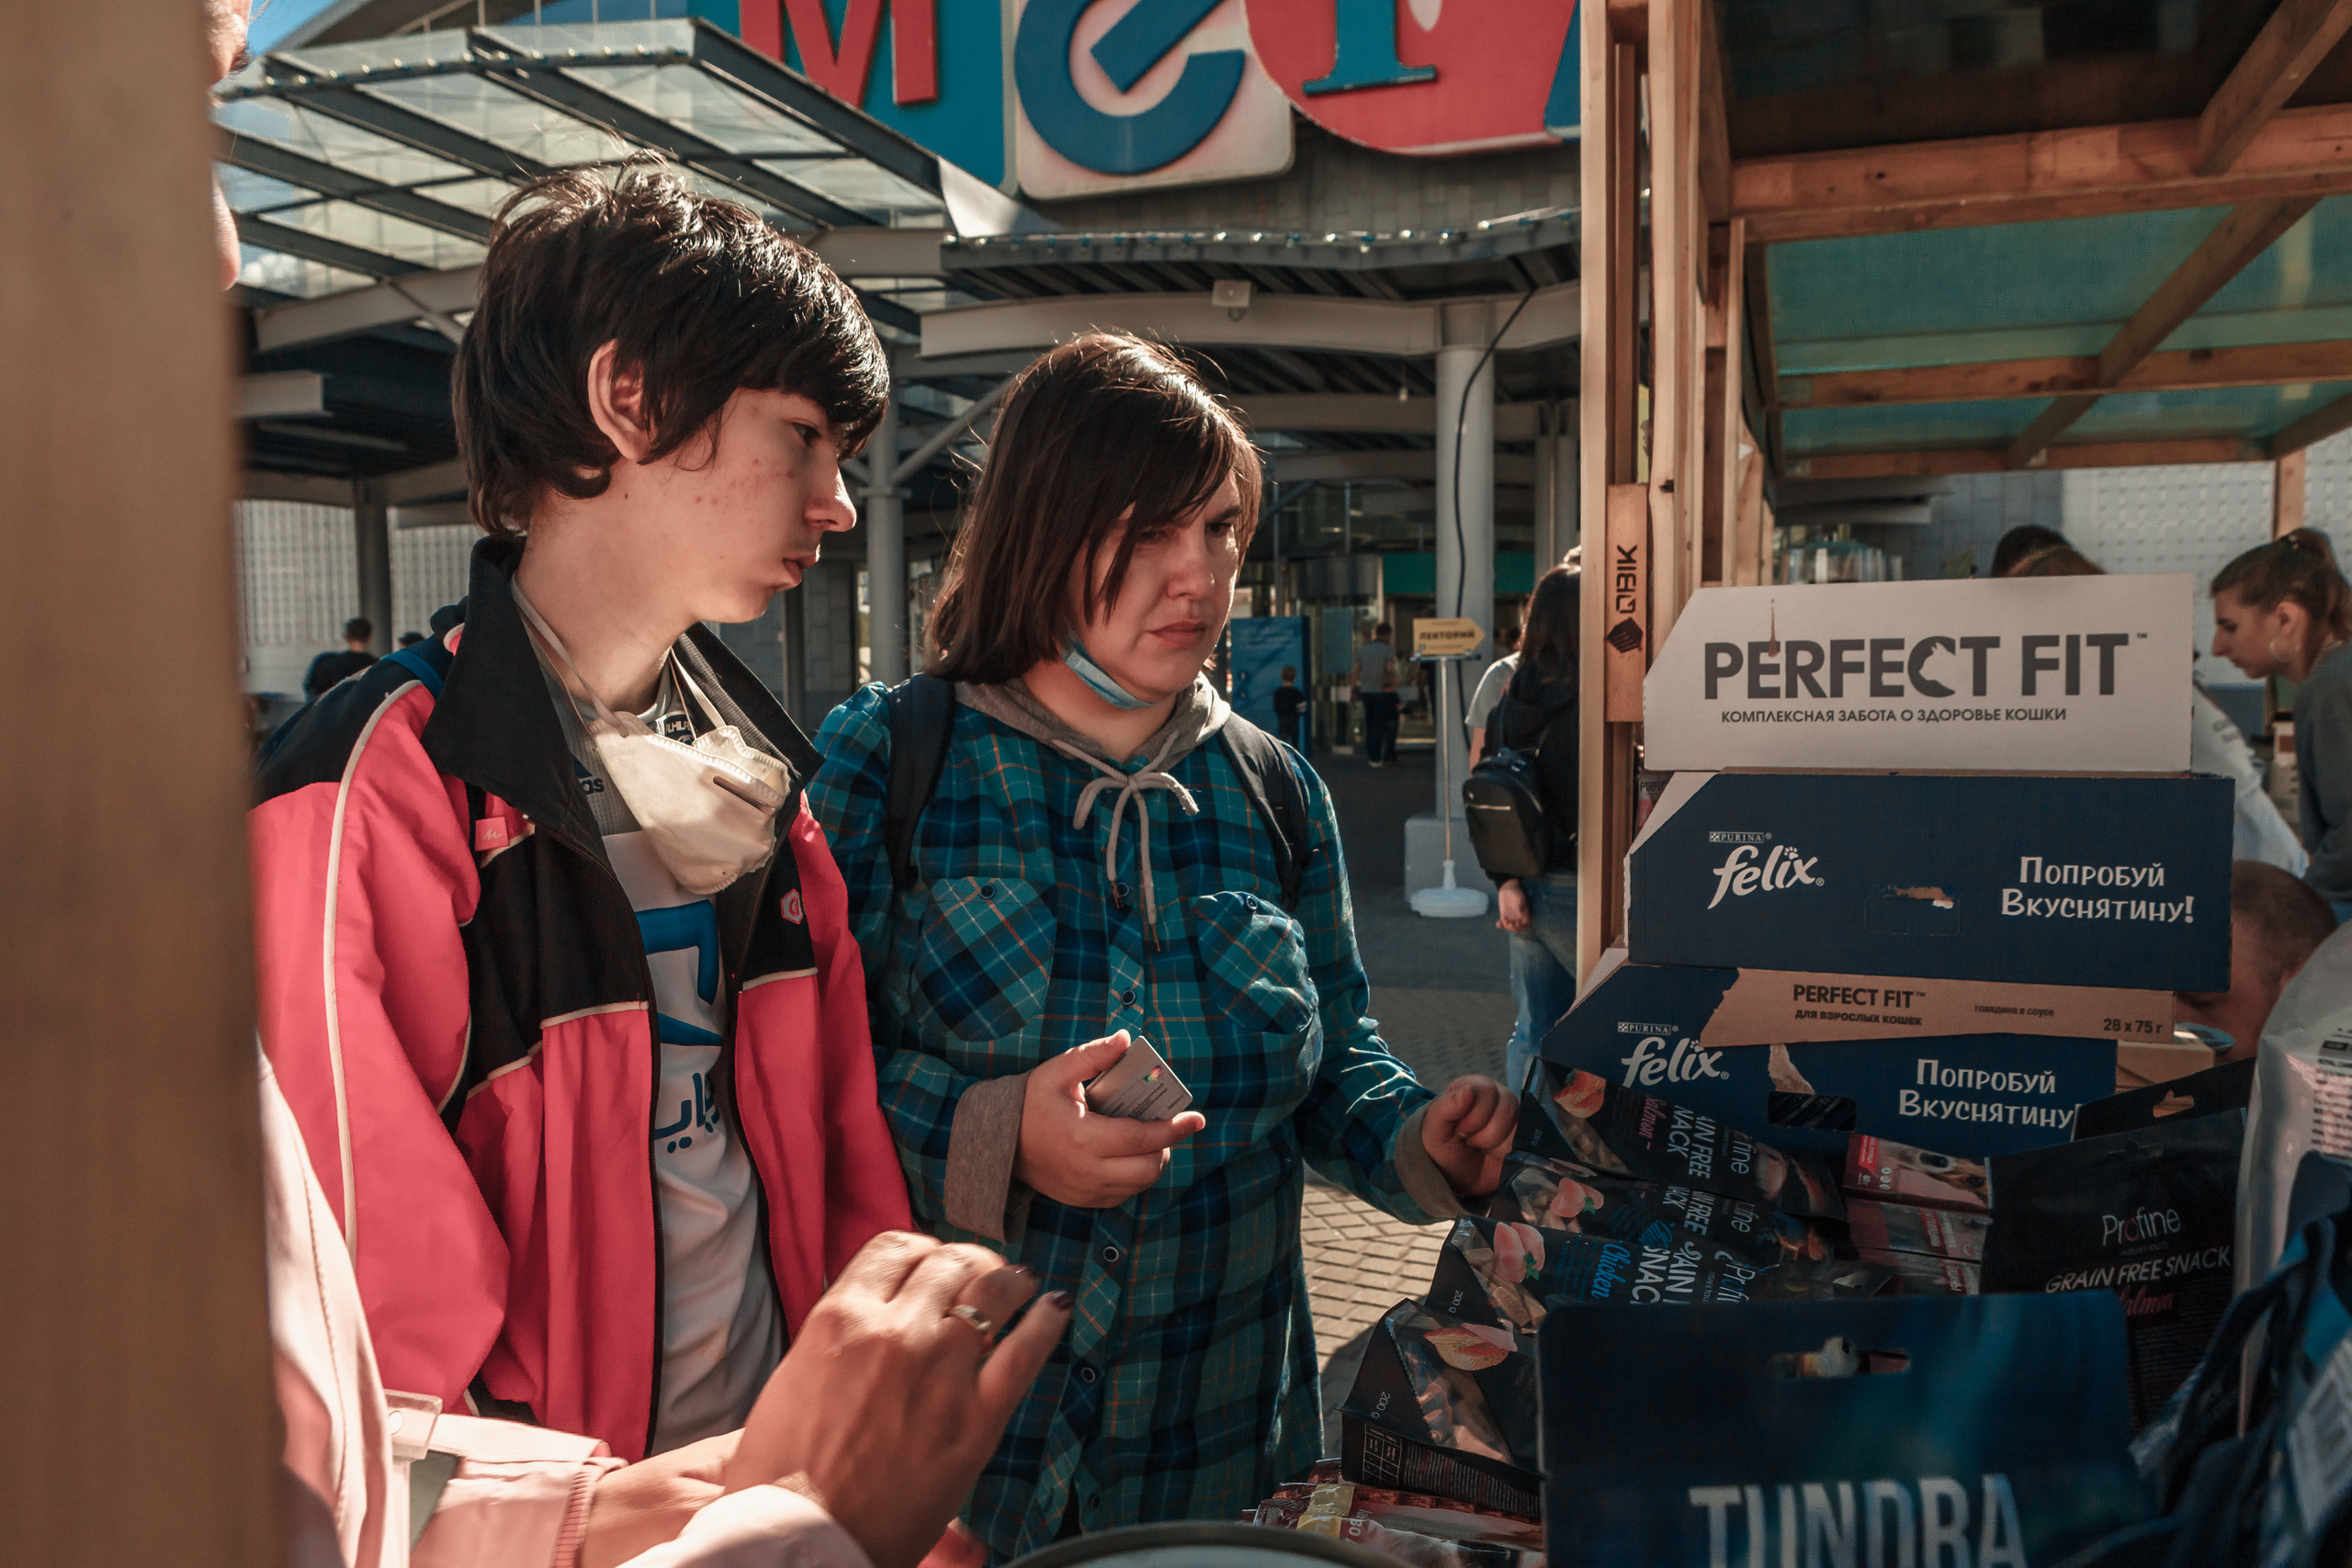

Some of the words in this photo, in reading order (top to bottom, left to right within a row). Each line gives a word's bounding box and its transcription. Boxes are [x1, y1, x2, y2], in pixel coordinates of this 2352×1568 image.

[1615, 545, 1637, 614] QBIK
[1704, 635, 2001, 700] PERFECT
[2021, 633, 2130, 696] FIT
[1722, 709, 1835, 724] КОМПЛЕКСНАЯ
[1838, 709, 1897, 723] ЗАБОТА
[1900, 708, 1915, 722] О
[1917, 708, 2002, 725] ЗДОРОВЬЕ
[2005, 708, 2067, 722] КОШКИ
[1721, 832, 1762, 842] PURINA
[1708, 845, 1818, 909] felix
[1792, 984, 1878, 1007] PERFECT
[1883, 990, 1914, 1009] FIT
[1795, 1010, 1817, 1021] ДЛЯ
[1820, 1010, 1881, 1024] ВЗРОСЛЫХ
[1883, 1014, 1922, 1026] КОШЕК
[1973, 1004, 2018, 1015] говядина
[2027, 1007, 2055, 1018] соусе
[1628, 1024, 1670, 1034] PURINA
[2103, 1018, 2121, 1032] 28
[2135, 1020, 2154, 1033] 75
[1621, 1037, 1724, 1089] felix
[1688, 1143, 1714, 1179] FREE
[2102, 1206, 2181, 1247] Profine
[1589, 1243, 1632, 1301] Chicken
[2045, 1266, 2115, 1293] GRAIN
[2117, 1258, 2163, 1286] FREE
[2165, 1246, 2231, 1277] SNACK
[1453, 1290, 1464, 1306] 200
[1375, 1390, 1391, 1413] 200
